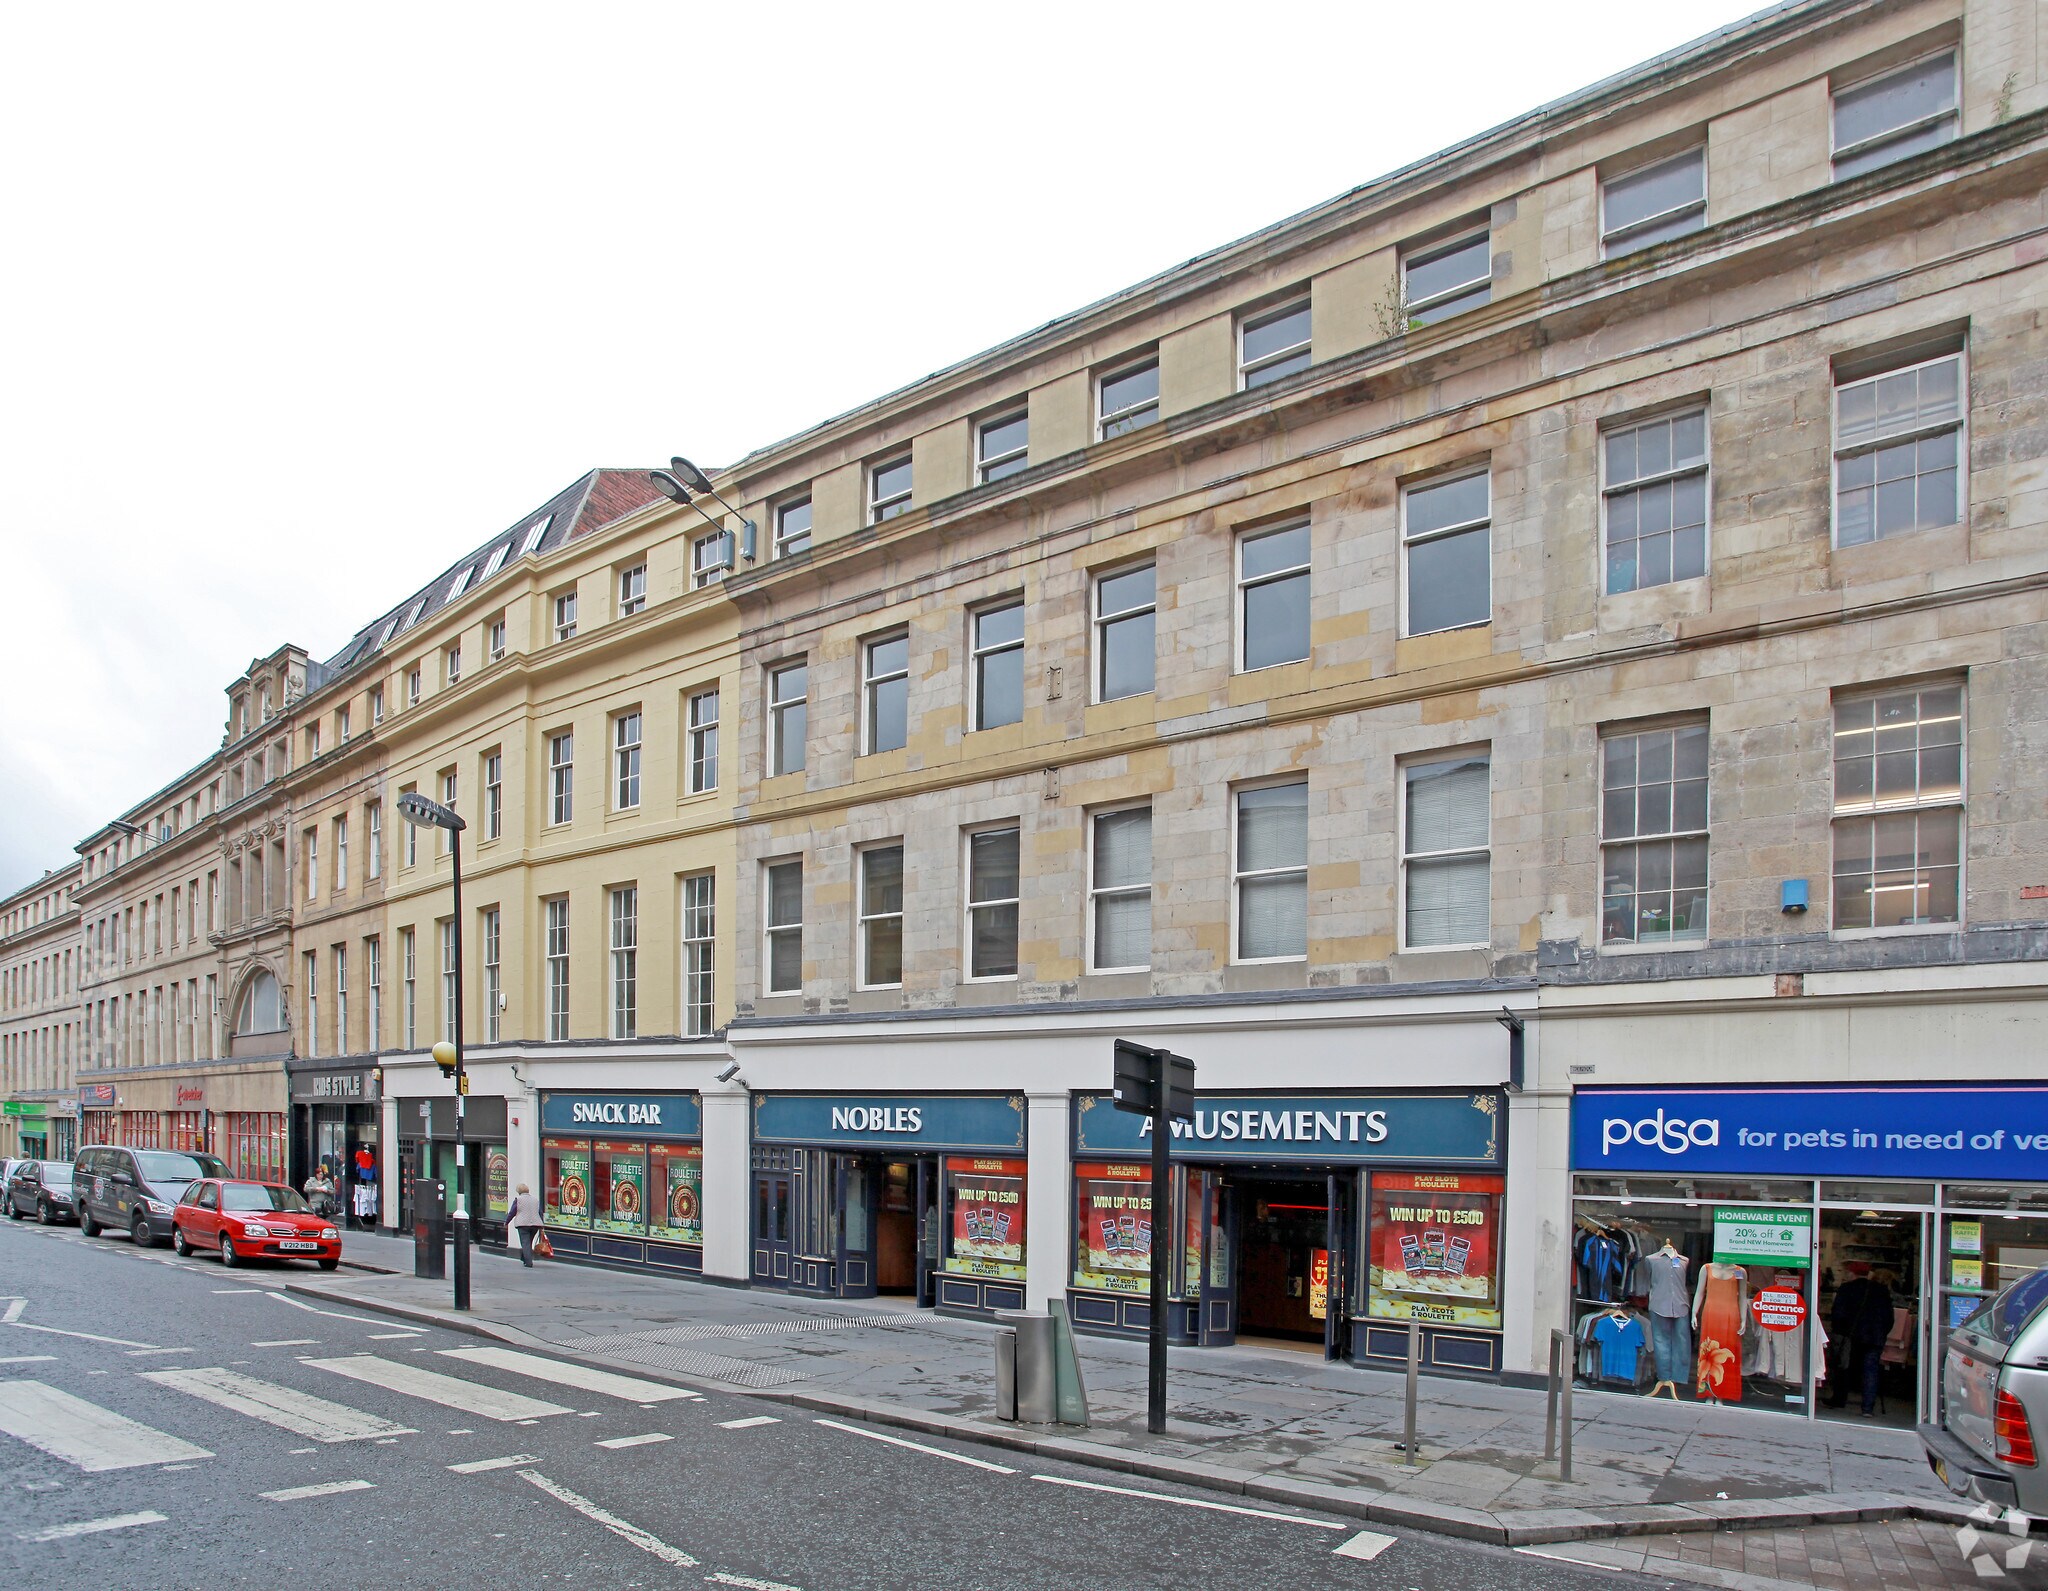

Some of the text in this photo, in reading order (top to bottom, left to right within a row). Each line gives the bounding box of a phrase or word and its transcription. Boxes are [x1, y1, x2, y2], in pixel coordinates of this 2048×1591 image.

[313, 1075, 360, 1097] KIDS STYLE
[573, 1102, 662, 1125] SNACK BAR
[832, 1106, 923, 1132] NOBLES
[1603, 1108, 1719, 1155] pdsa
[1737, 1127, 1777, 1147] for
[1783, 1129, 1847, 1151] pets
[1853, 1128, 1878, 1148] in
[1885, 1130, 1963, 1150] need
[1970, 1130, 2005, 1150] of
[561, 1160, 588, 1170] ROULETTE
[613, 1164, 642, 1175] ROULETTE
[670, 1168, 702, 1179] ROULETTE
[959, 1189, 1019, 1204] WIN UP TO £500
[1093, 1196, 1111, 1208] WIN
[1114, 1197, 1126, 1209] UP
[1127, 1198, 1139, 1209] TO
[561, 1205, 587, 1216] WIN UP TO
[614, 1211, 641, 1222] WIN UP TO
[1390, 1207, 1484, 1225] WIN UP TO £500
[671, 1217, 700, 1229] WIN UP TO
[1717, 1211, 1807, 1223] HOMEWARE EVENT
[1735, 1228, 1773, 1239] 20% off
[1752, 1301, 1804, 1314] Clearance
[1417, 1312, 1455, 1321] ROULETTE
